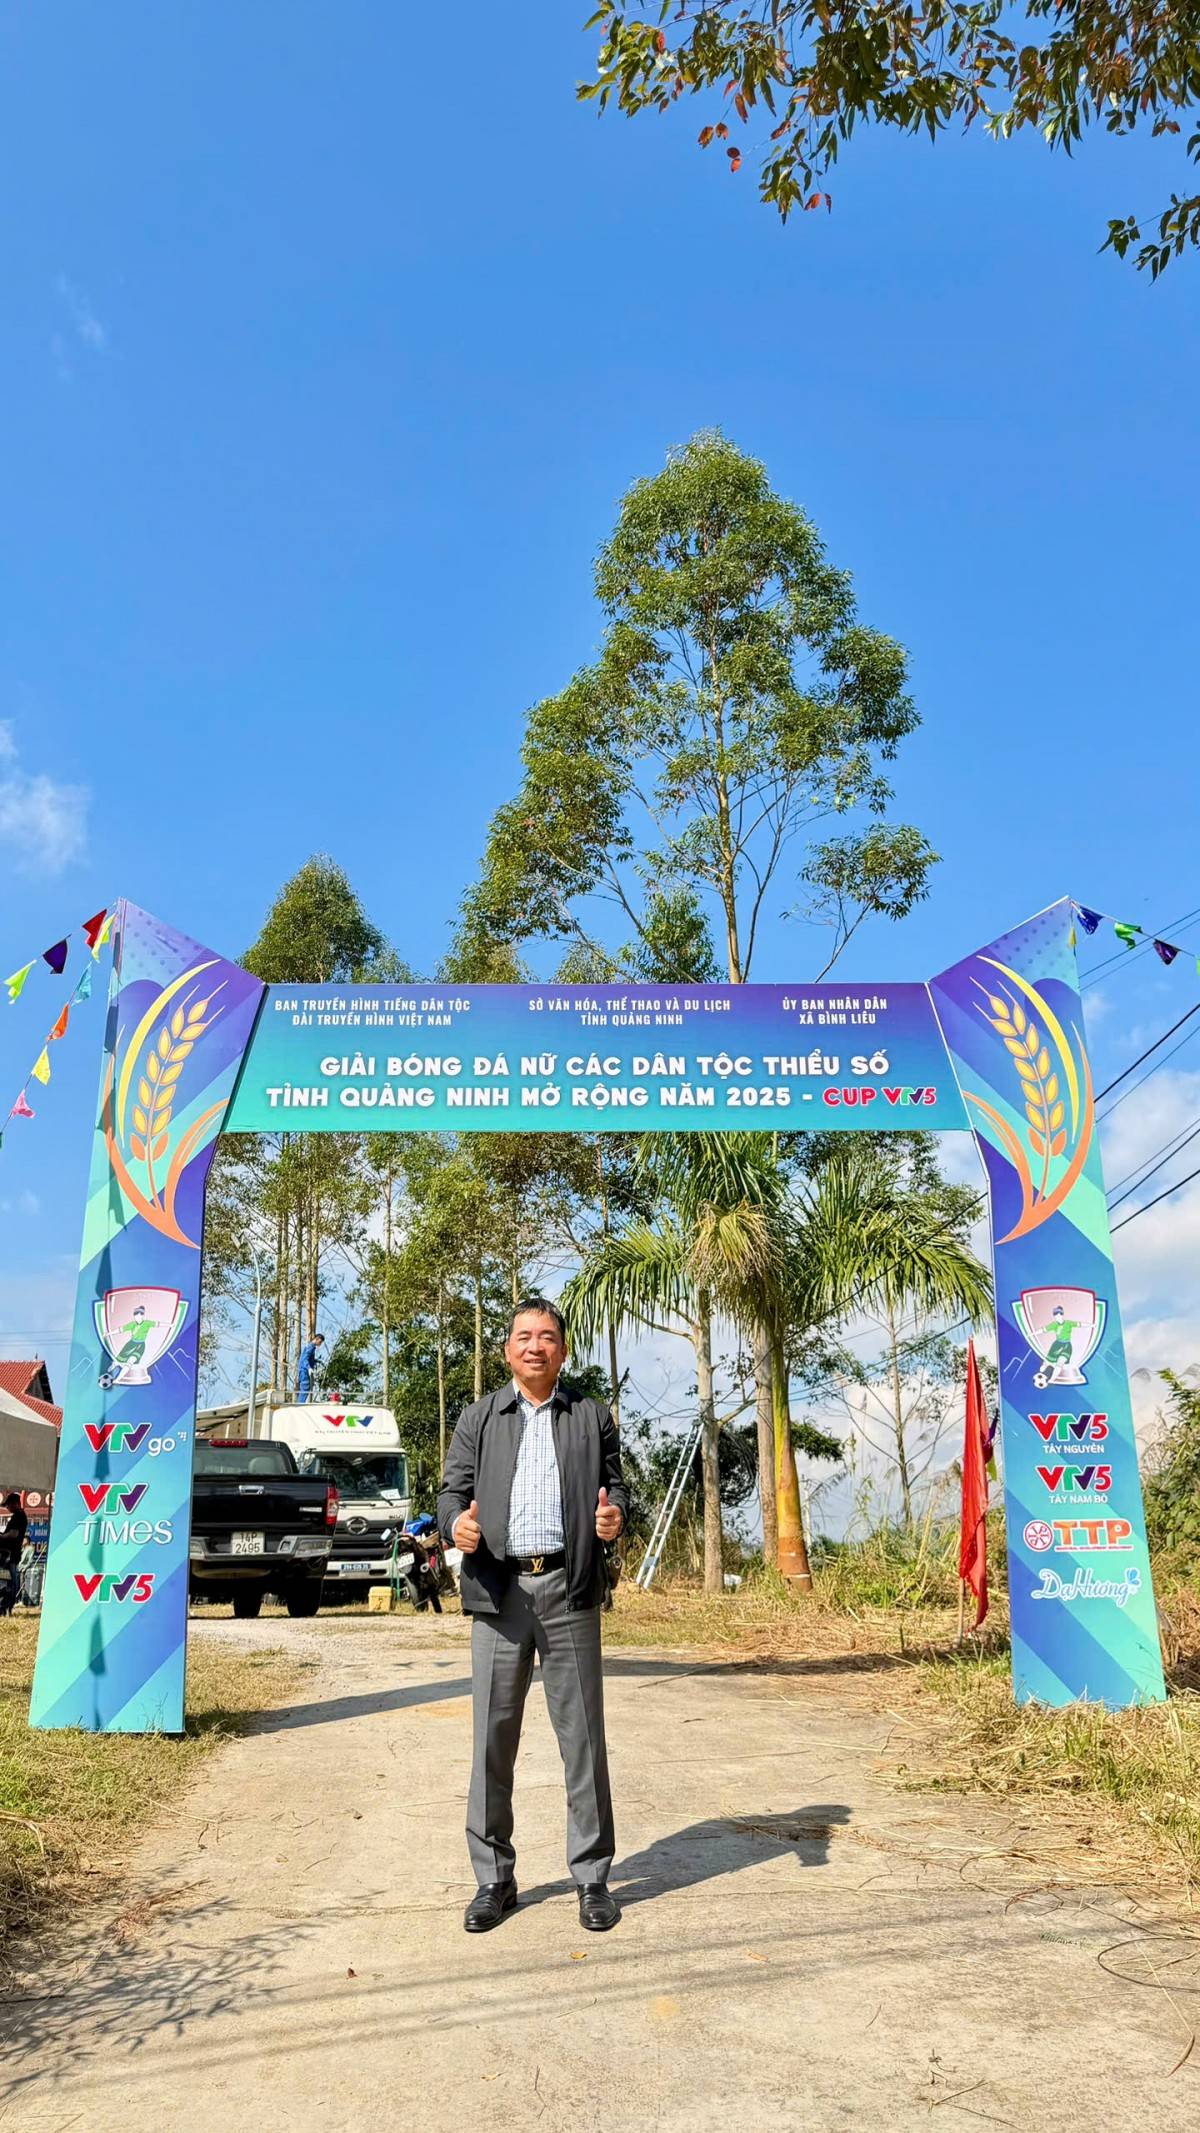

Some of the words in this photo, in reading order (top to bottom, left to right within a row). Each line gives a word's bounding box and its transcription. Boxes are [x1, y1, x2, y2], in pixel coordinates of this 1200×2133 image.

[275, 1000, 298, 1011] BAN
[351, 997, 379, 1011] HÌNH
[384, 995, 416, 1011] TIẾNG
[421, 998, 443, 1011] DÂN
[449, 998, 471, 1013] TỘC
[575, 997, 602, 1012] HÓA,
[631, 1000, 661, 1011] THAO
[665, 996, 680, 1011] VÀ
[685, 1000, 700, 1011] DU
[704, 1000, 731, 1013] LỊCH
[801, 999, 825, 1010] BAN
[829, 996, 860, 1010] NHÂN
[864, 996, 888, 1010] DÂN
[366, 1012, 394, 1026] HÌNH
[399, 1011, 423, 1028] VIỆT
[427, 1015, 452, 1026] NAM
[655, 1014, 683, 1025] NINH
[799, 1011, 814, 1025] XÃ
[818, 1011, 847, 1025] BÌNH
[850, 1011, 876, 1025] LIÊU
[320, 1052, 375, 1076] GIẢI
[387, 1053, 462, 1076] BÓNG
[473, 1053, 510, 1076] ĐÁ
[521, 1053, 558, 1076] NỮ
[566, 1053, 621, 1076] CÁC
[633, 1052, 686, 1076] DÂN
[697, 1053, 753, 1080] TỘC
[763, 1048, 840, 1076] THIỂU
[851, 1049, 890, 1076] SỐ
[266, 1082, 328, 1107] TỈNH
[339, 1082, 435, 1107] QUẢNG
[446, 1087, 510, 1107] NINH
[521, 1082, 561, 1107] MỞ
[572, 1083, 649, 1110] RỘNG
[660, 1083, 715, 1107] NĂM
[727, 1087, 791, 1106] 2025
[823, 1086, 876, 1107] CUP
[882, 1087, 937, 1106] VTV5
[83, 1422, 152, 1453] VTV
[148, 1437, 176, 1457] go
[1028, 1413, 1109, 1442] VTV5
[1035, 1464, 1112, 1493] VTV5
[78, 1482, 149, 1515] VTV
[1052, 1519, 1132, 1546] TTP
[235, 1542, 261, 1554] 2495
[73, 1573, 155, 1604] VTV5
